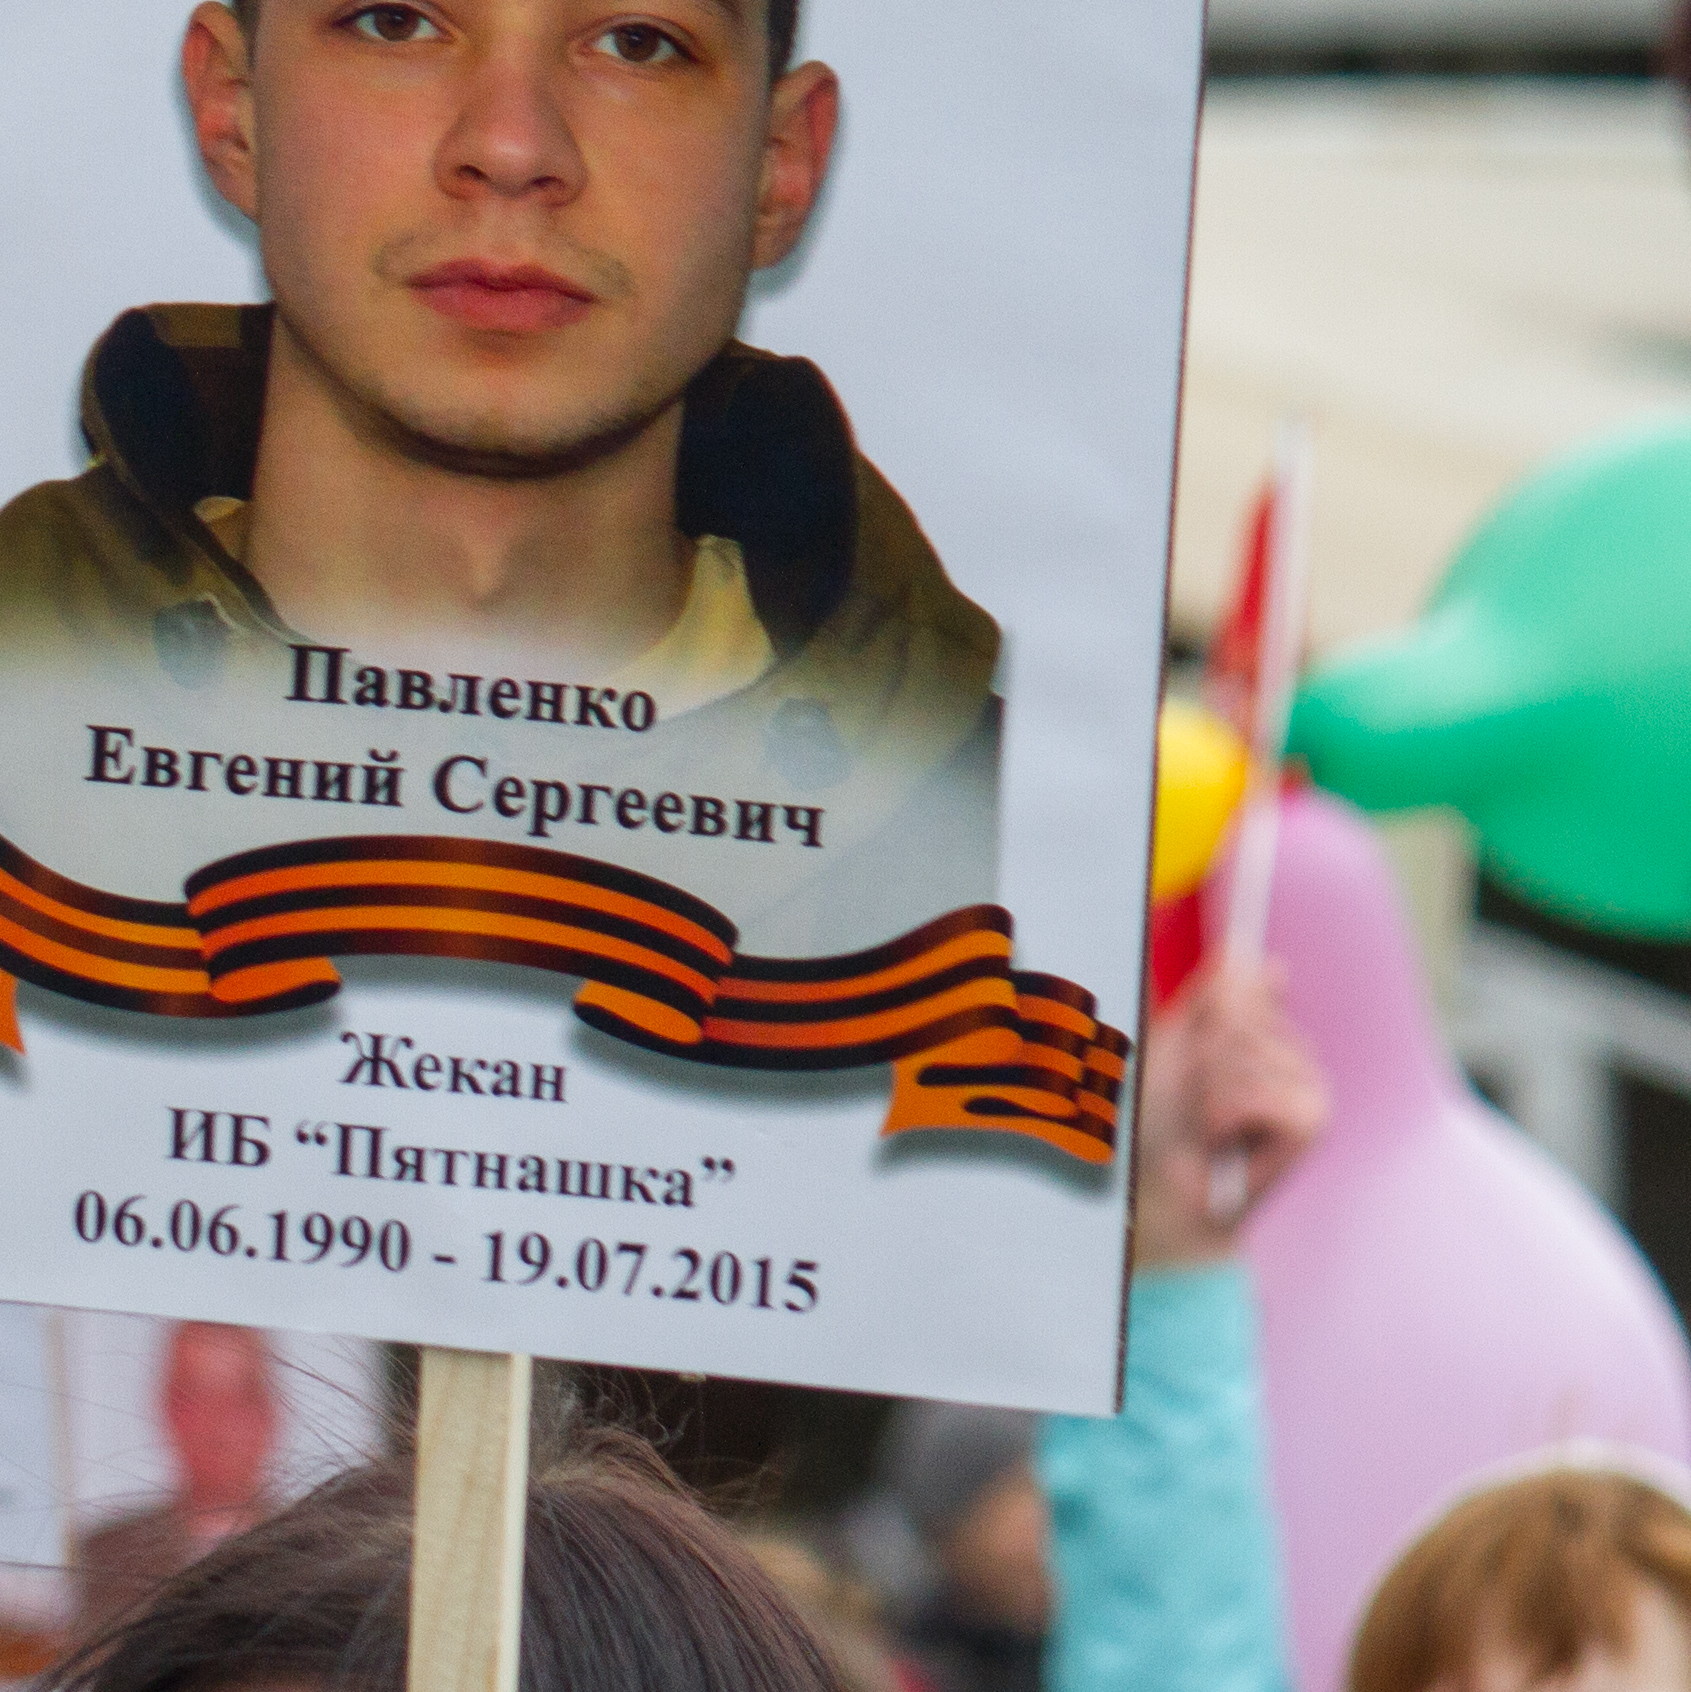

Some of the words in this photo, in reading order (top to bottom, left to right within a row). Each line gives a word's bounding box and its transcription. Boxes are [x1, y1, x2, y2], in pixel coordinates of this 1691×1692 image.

[284, 642, 658, 735] Павленко
[83, 723, 405, 809] Евгений
[430, 753, 827, 850] Сергеевич
[337, 1030, 567, 1105] Жекан
[165, 1106, 273, 1168] ИБ
[71, 1190, 414, 1275] 06.06.1990
[484, 1230, 822, 1316] 19.07.2015
